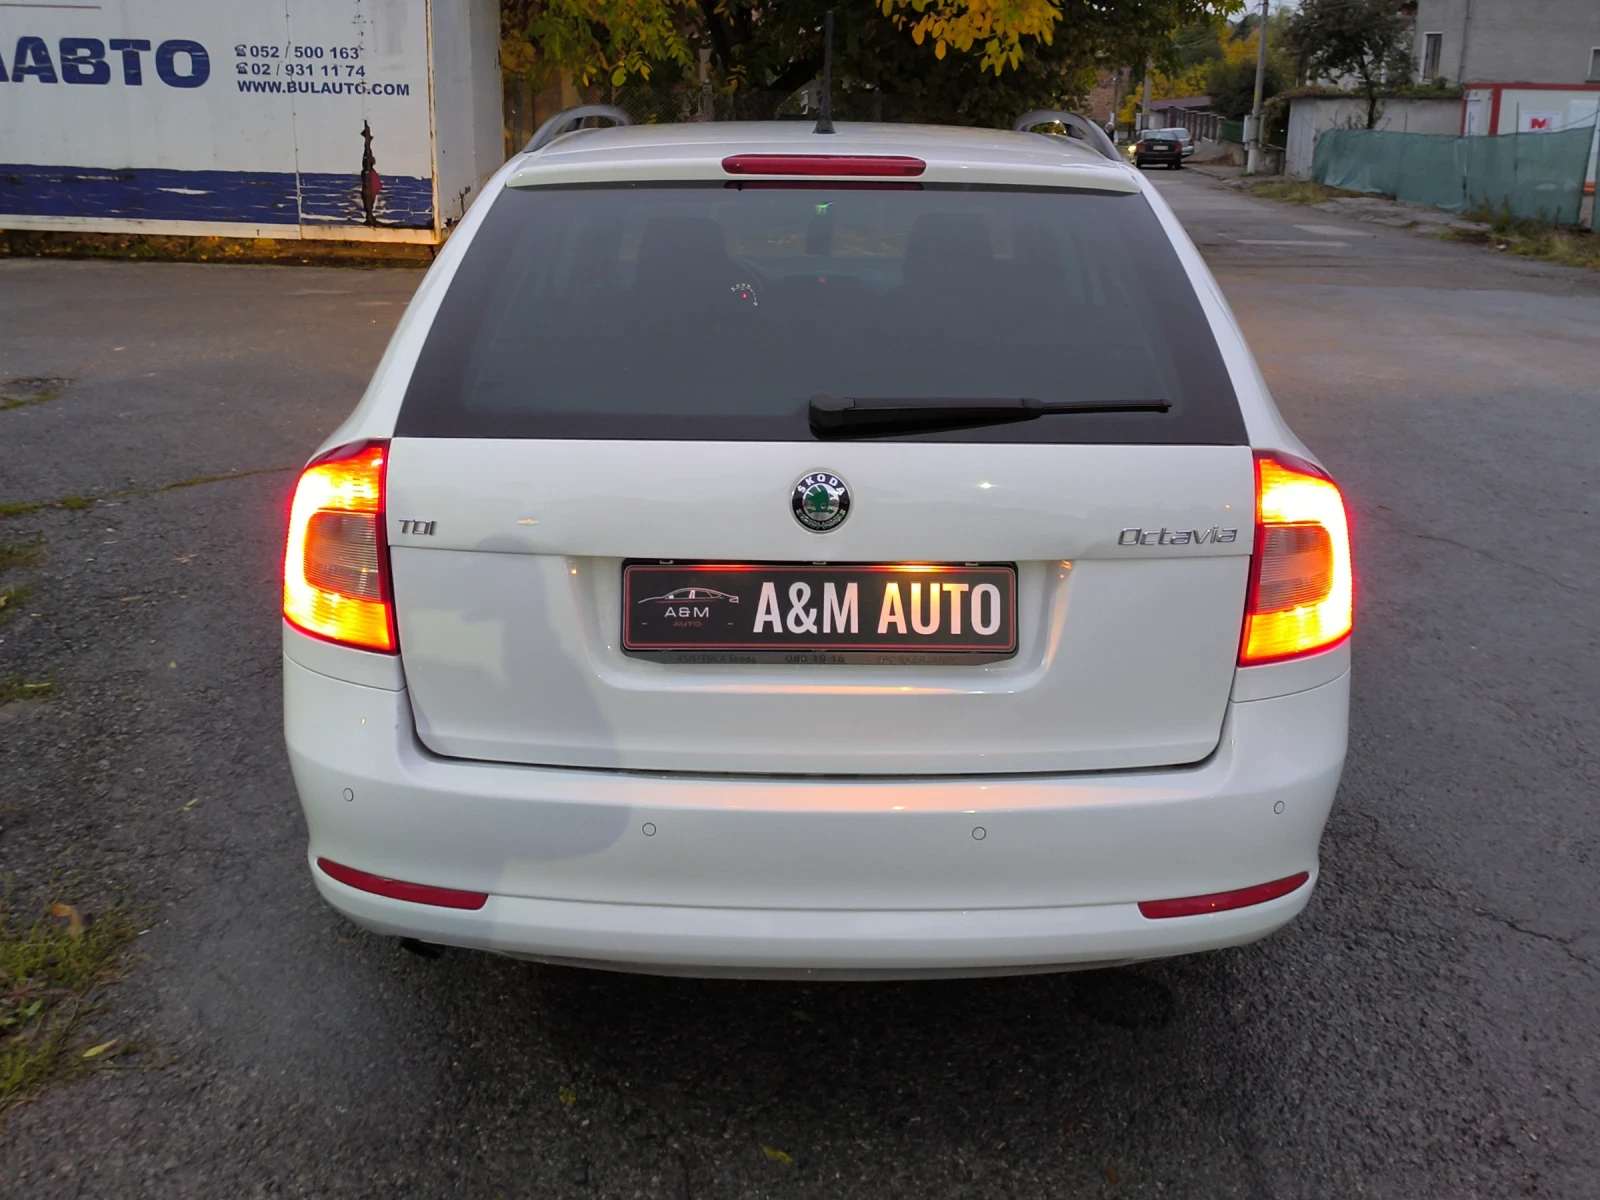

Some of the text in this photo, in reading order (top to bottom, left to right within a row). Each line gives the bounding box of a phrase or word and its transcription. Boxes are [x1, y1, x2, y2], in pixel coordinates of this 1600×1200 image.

[250, 45, 280, 58] 052
[294, 46, 324, 59] 500
[330, 47, 359, 60] 163
[0, 36, 211, 88] АВТО
[251, 63, 271, 75] 02
[285, 64, 314, 76] 931
[320, 64, 339, 77] 11
[345, 65, 366, 77] 74
[237, 80, 410, 96] WWW.BULAUTO.COM
[398, 519, 438, 536] TDI
[1117, 525, 1238, 546] Octavia
[753, 581, 1001, 636] A&M AUTO
